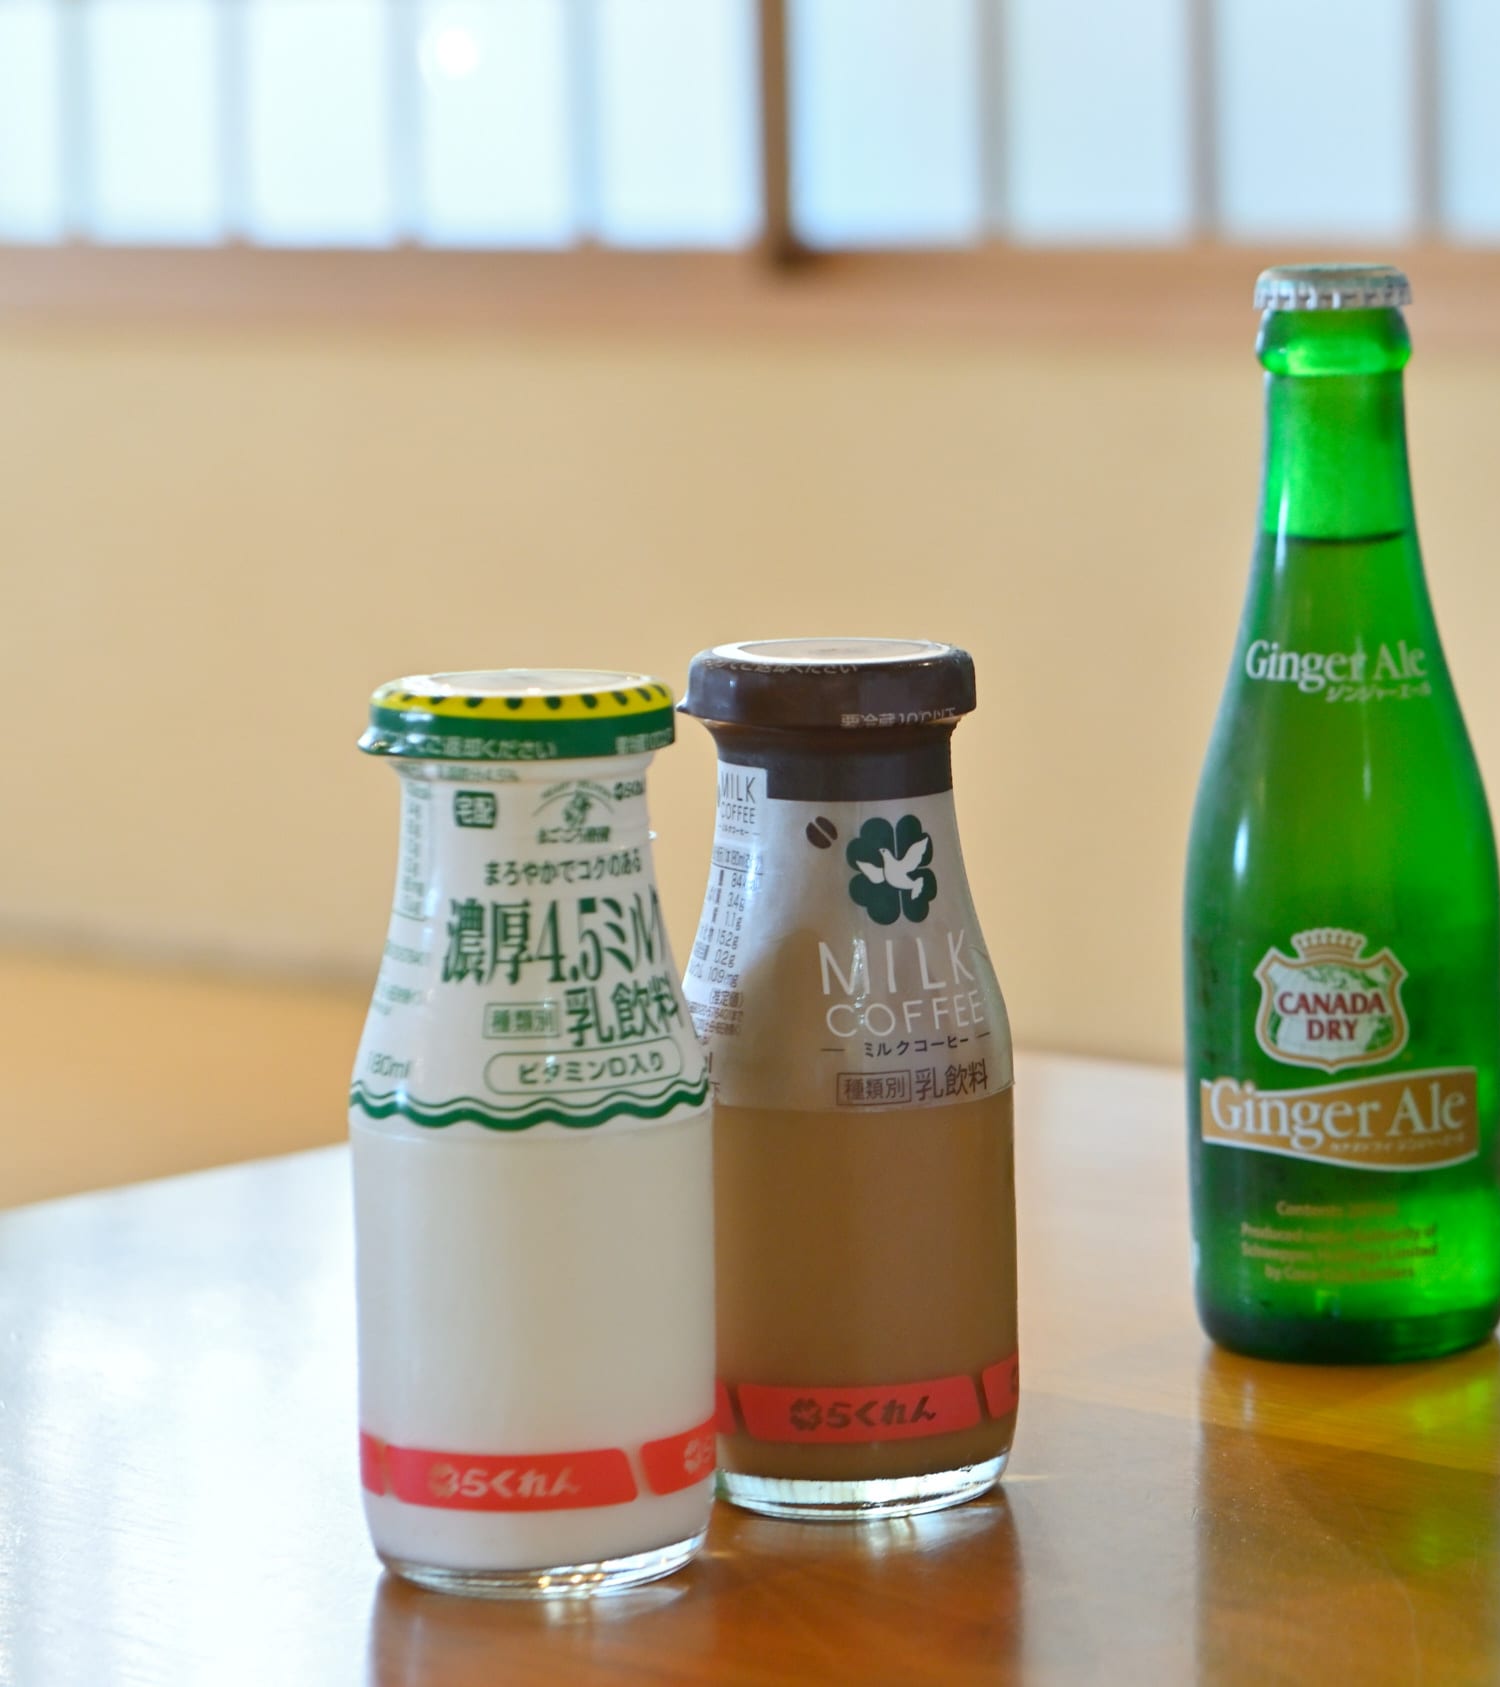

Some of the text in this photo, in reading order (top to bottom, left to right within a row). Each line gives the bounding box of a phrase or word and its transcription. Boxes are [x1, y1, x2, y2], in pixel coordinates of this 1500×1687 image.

[1245, 639, 1427, 693] Ginger Ale
[818, 929, 975, 995] MILK
[826, 989, 985, 1038] COFFEE
[1277, 992, 1387, 1016] CANADA
[864, 1036, 968, 1058] ミルクコーヒー
[1306, 1019, 1358, 1041] DRY
[915, 1058, 988, 1101] 乳飲料
[1209, 1077, 1467, 1151] Ginger Ale
[825, 1395, 938, 1430] らくれん
[459, 1467, 583, 1498] らくれん
